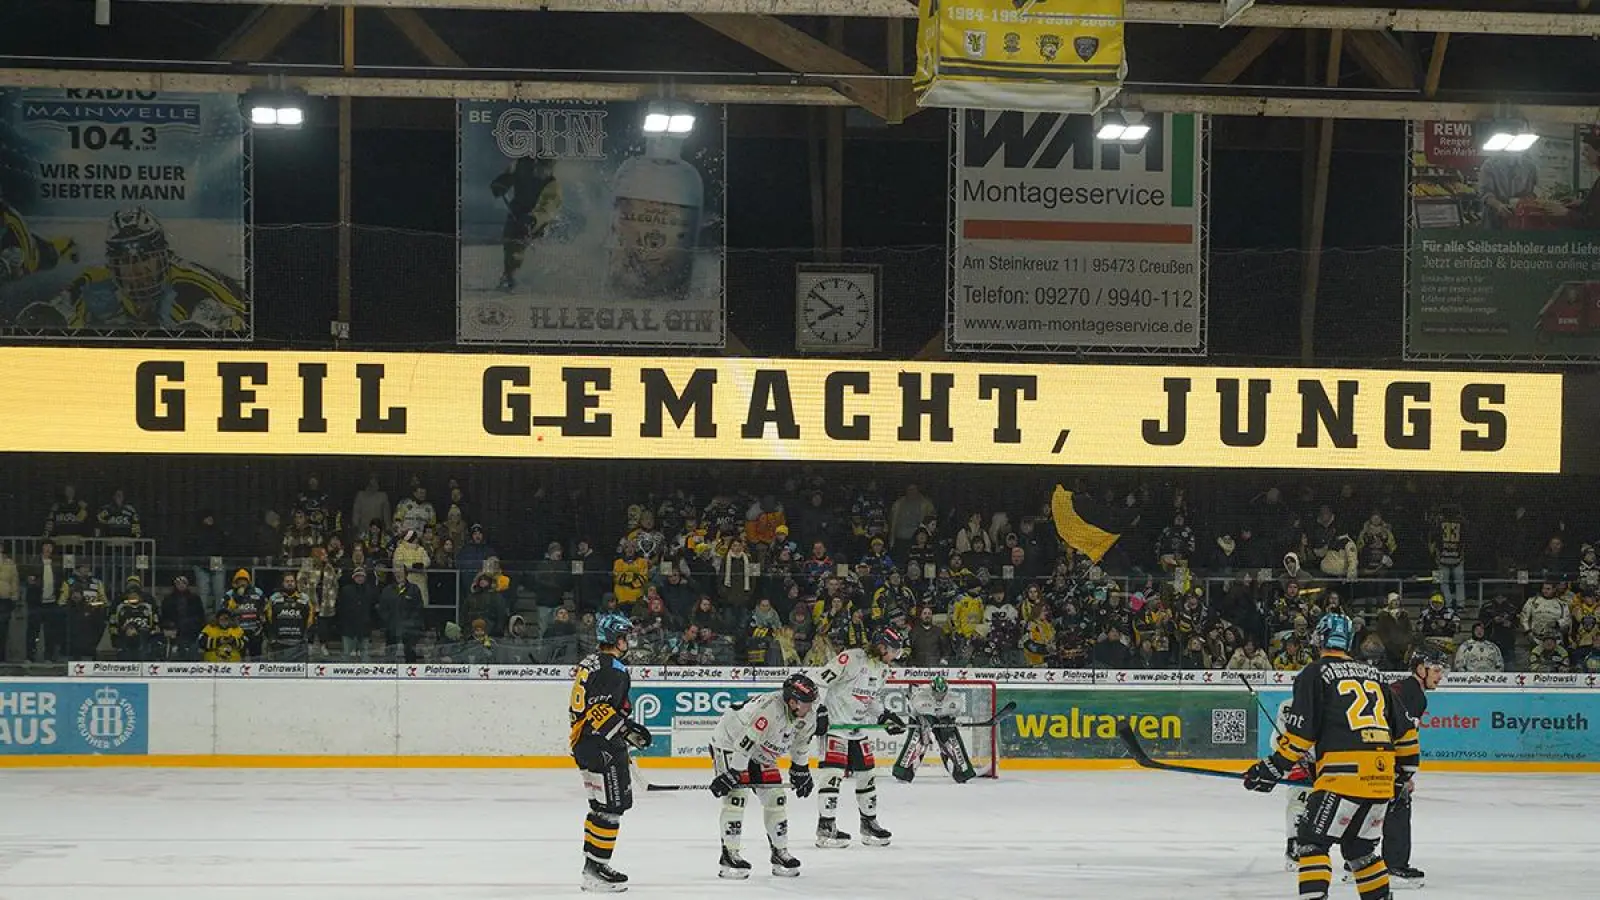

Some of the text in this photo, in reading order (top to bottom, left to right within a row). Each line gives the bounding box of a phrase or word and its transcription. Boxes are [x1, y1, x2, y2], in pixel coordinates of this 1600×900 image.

[27, 105, 198, 120] MAINWELLE
[469, 110, 492, 124] BE
[492, 108, 608, 160] GIN
[963, 109, 1164, 172] WAM
[40, 163, 186, 181] WIR SIND EUER
[40, 183, 186, 201] SIEBTER MANN
[962, 179, 1165, 209] Montageservice
[1422, 240, 1443, 253] Für
[1444, 240, 1466, 253] alle
[1467, 240, 1547, 254] Selbstabholer
[1548, 241, 1568, 254] und
[962, 256, 985, 271] Am
[988, 256, 1059, 272] Steinkreuz
[1065, 258, 1079, 273] 11
[1092, 259, 1135, 273] 95473
[1139, 259, 1194, 275] Creußen
[1422, 255, 1450, 269] Jetzt
[1454, 256, 1493, 269] einfach
[1496, 256, 1508, 269] &
[1510, 257, 1553, 271] bequem
[1556, 259, 1589, 271] online
[962, 286, 1030, 305] Telefon:
[1035, 287, 1091, 306] 09270
[1107, 288, 1194, 308] 9940-112
[529, 306, 660, 331] ILLEGAL
[662, 309, 714, 333] GIN
[963, 317, 1194, 335] www.wam-montageservice.de
[135, 360, 1507, 454] GEIL GEMACHT, JUNGS
[93, 663, 141, 673] Piotrowski
[167, 665, 232, 675] www.pio-24.de
[258, 664, 306, 674] Piotrowski
[333, 666, 398, 676] www.pio-24.de
[424, 665, 470, 675] Piotrowski
[498, 667, 561, 677] www.pio-24.de
[658, 669, 722, 679] www.pio-24.de
[743, 668, 790, 678] Piotrowski
[903, 669, 950, 679] Piotrowski
[1062, 670, 1109, 680] Piotrowski
[821, 669, 838, 684] 47
[974, 671, 1038, 681] www.pio-24.de
[1133, 672, 1196, 682] www.pio-24.de
[1220, 672, 1266, 682] Piotrowski
[1447, 675, 1508, 685] www.pio-24.de
[1533, 674, 1578, 684] Piotrowski
[1419, 711, 1589, 733] Center Bayreuth
[739, 735, 755, 752] 91
